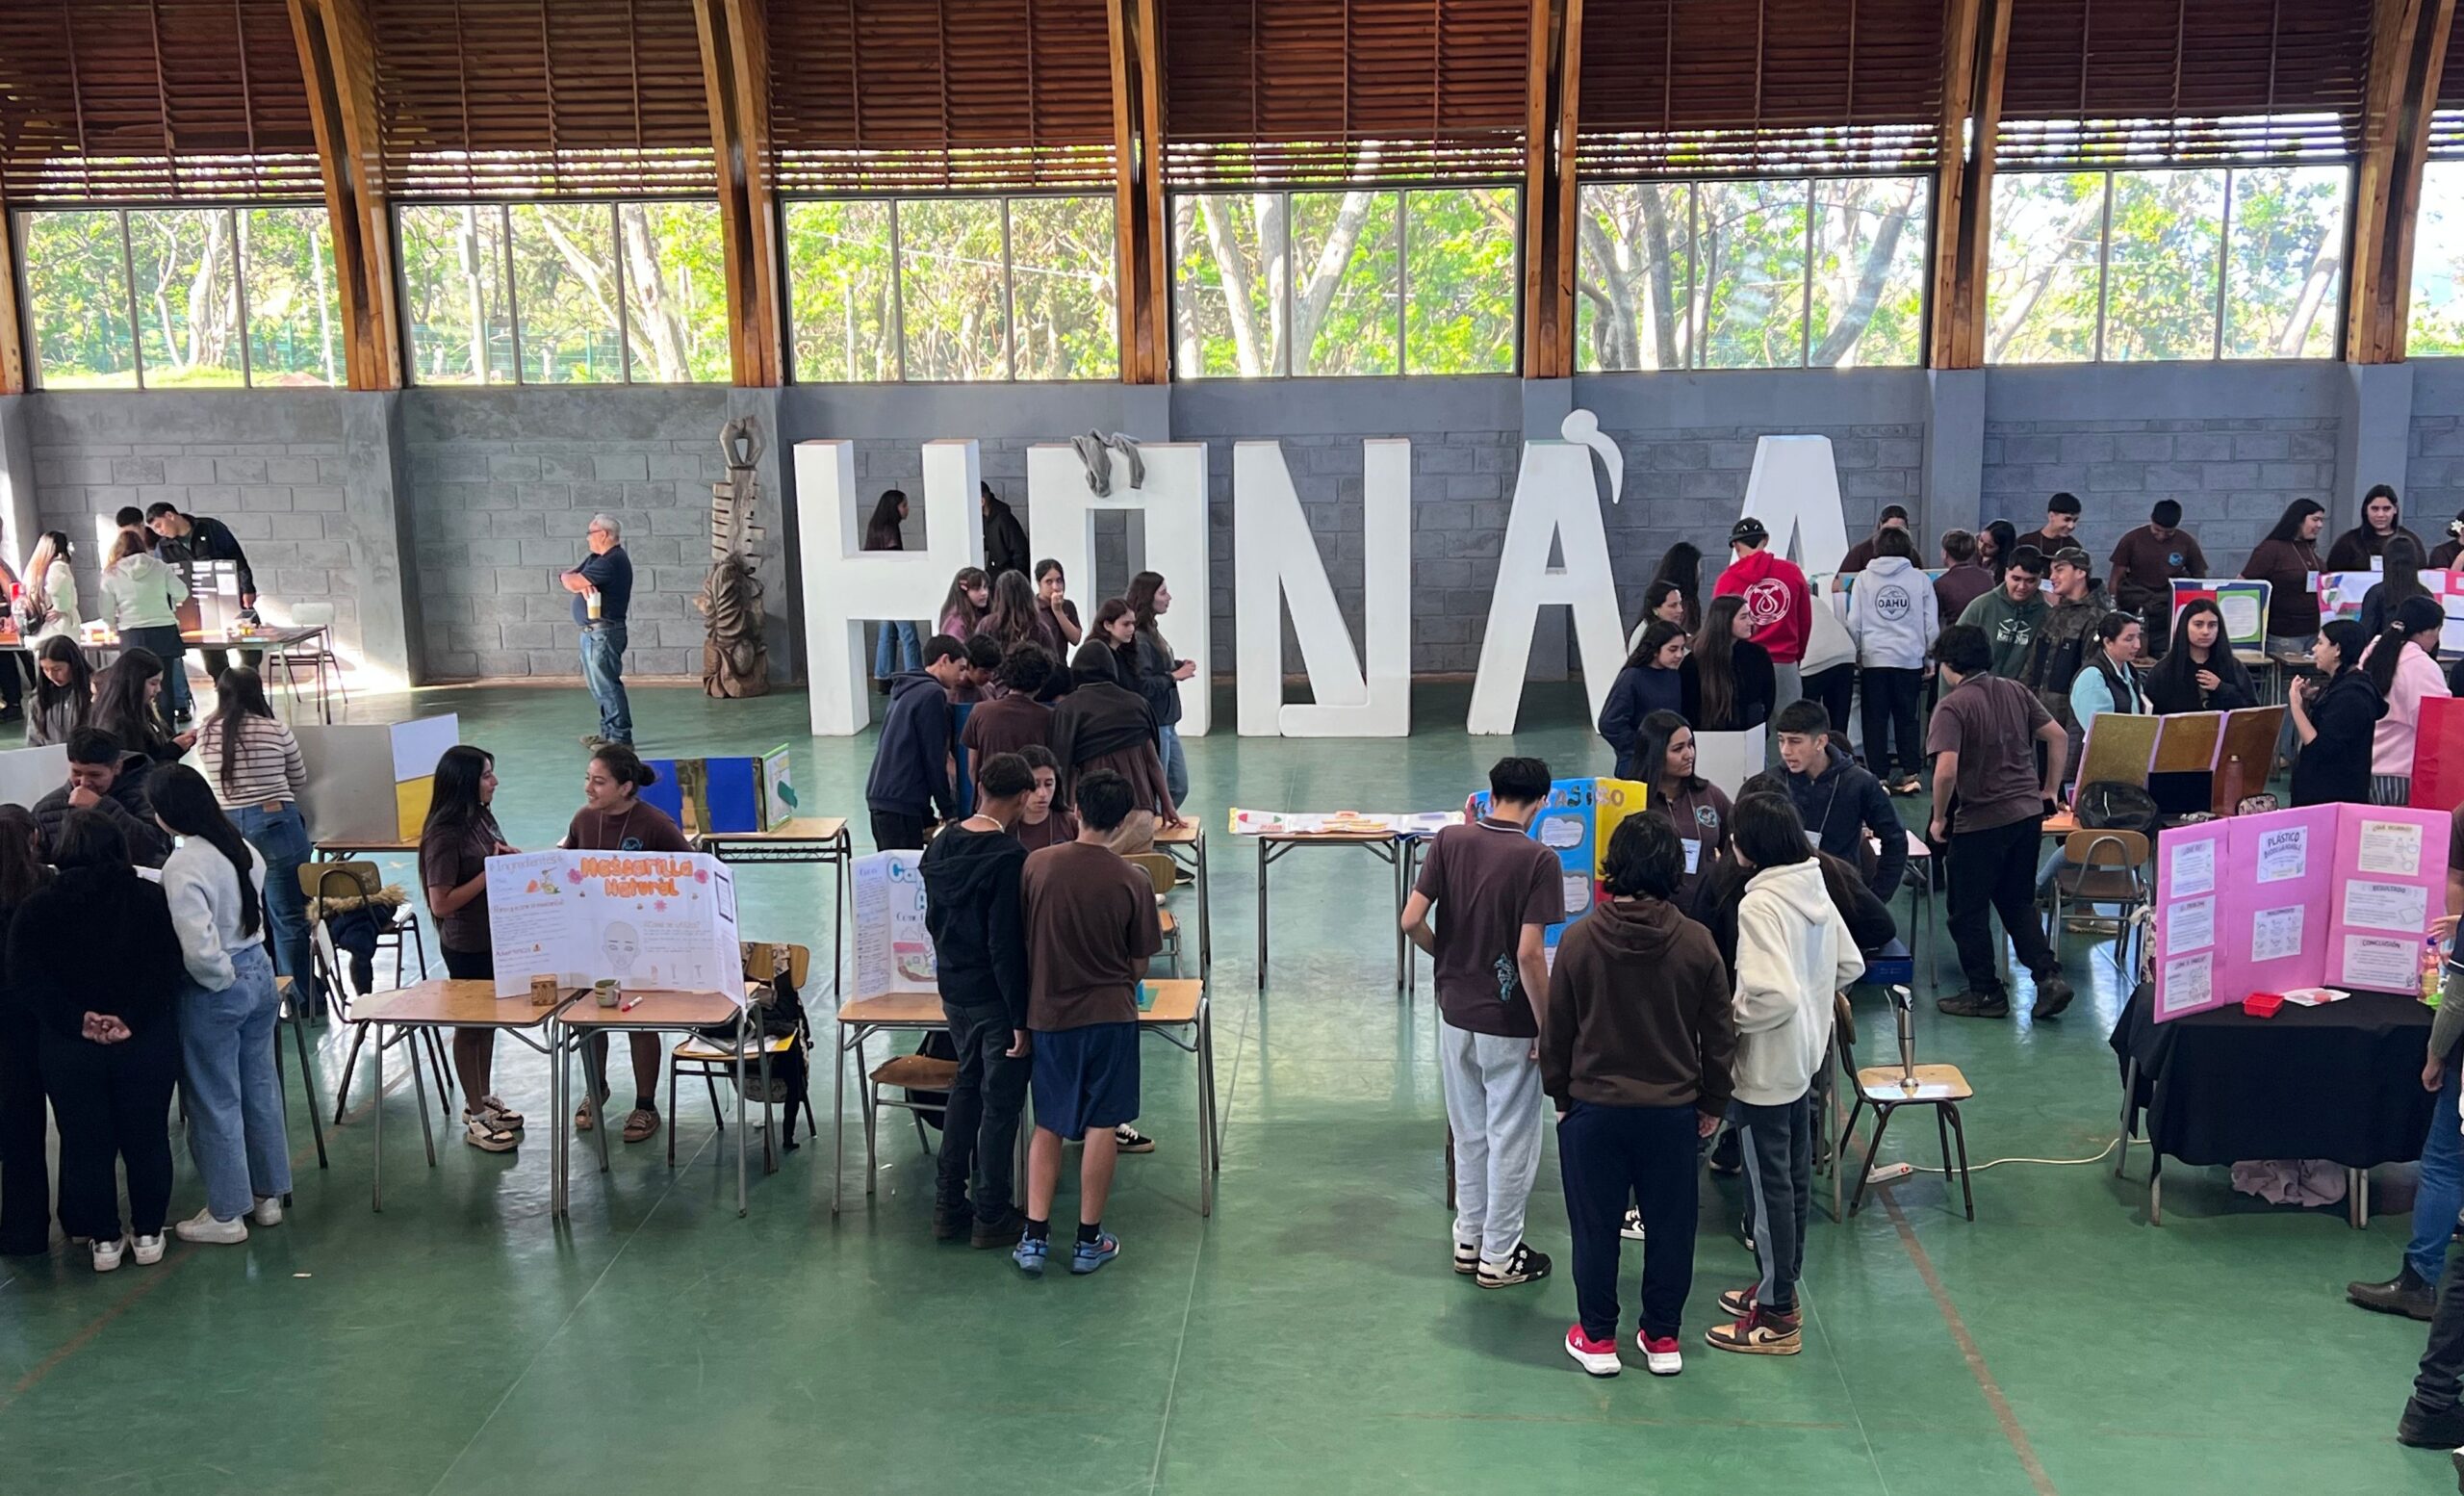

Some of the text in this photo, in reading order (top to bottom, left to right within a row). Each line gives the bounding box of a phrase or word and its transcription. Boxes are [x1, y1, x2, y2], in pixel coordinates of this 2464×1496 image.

[1878, 599, 1908, 608] OAHU
[2267, 831, 2300, 848] PLÁSTICO
[2362, 939, 2401, 948] CONCLUSIÓN
